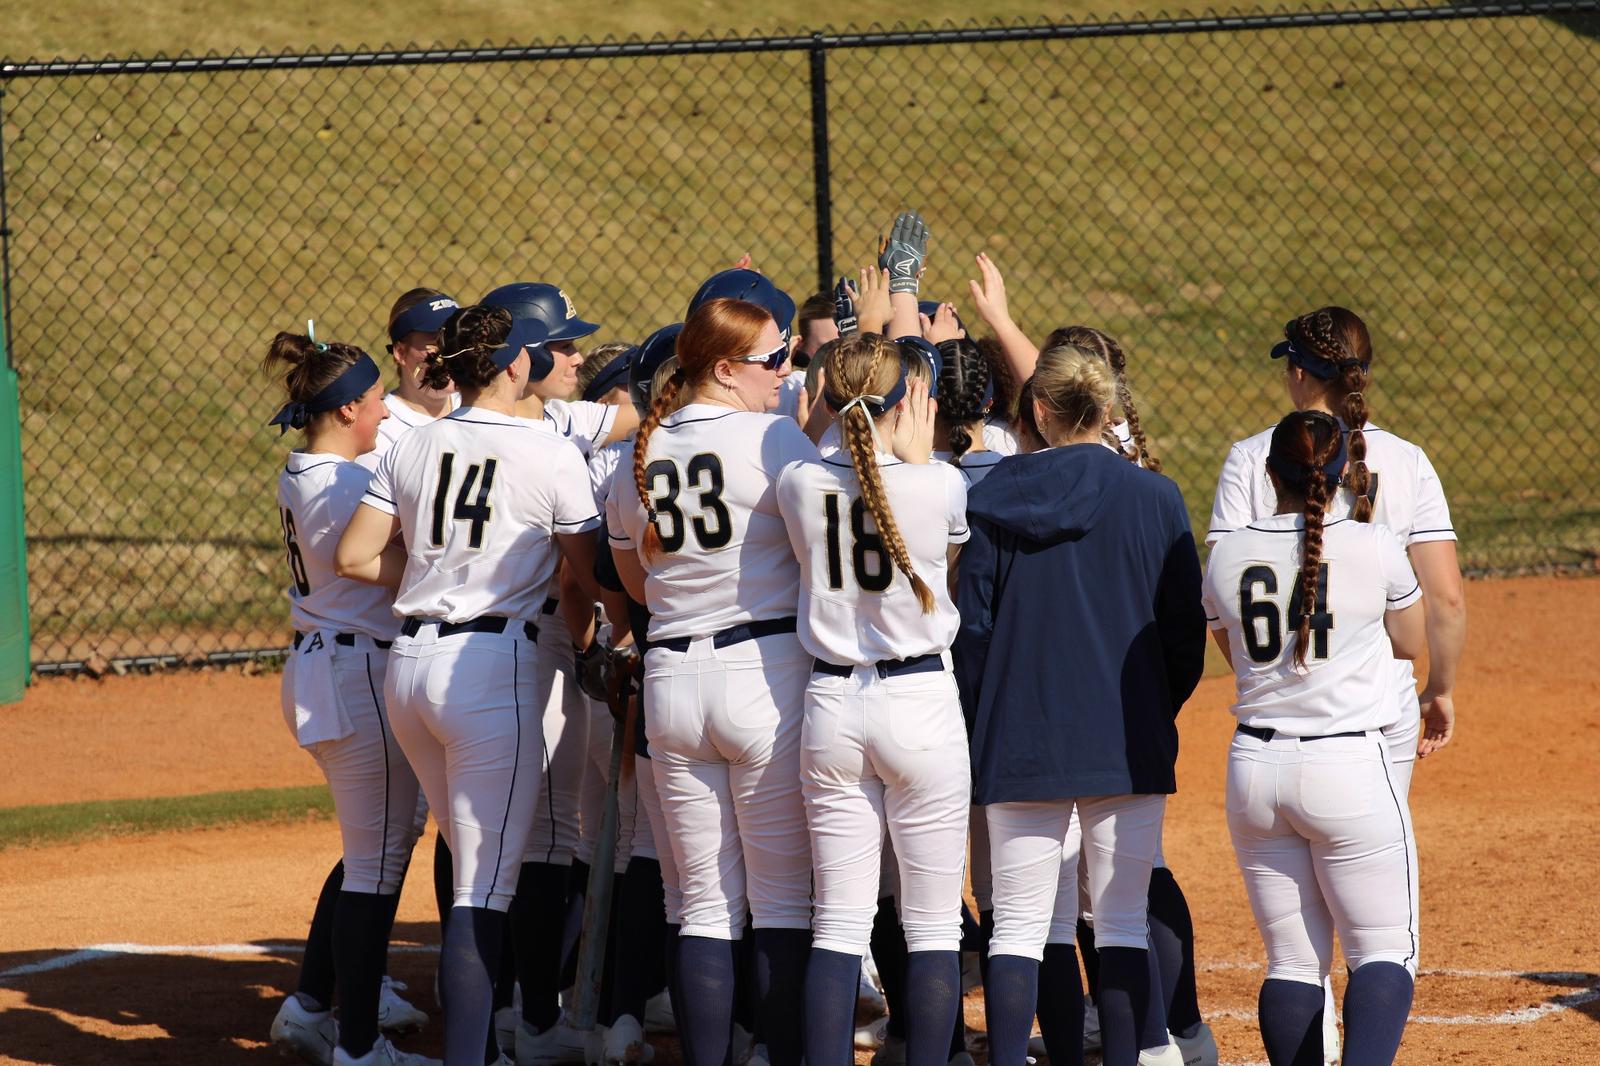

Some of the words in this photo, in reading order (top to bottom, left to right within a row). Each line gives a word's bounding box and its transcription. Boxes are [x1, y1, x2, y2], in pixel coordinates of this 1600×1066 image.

[431, 451, 498, 551] 14
[645, 452, 732, 553] 33
[824, 492, 893, 592] 18
[303, 631, 325, 655] A
[1239, 560, 1335, 664] 64
